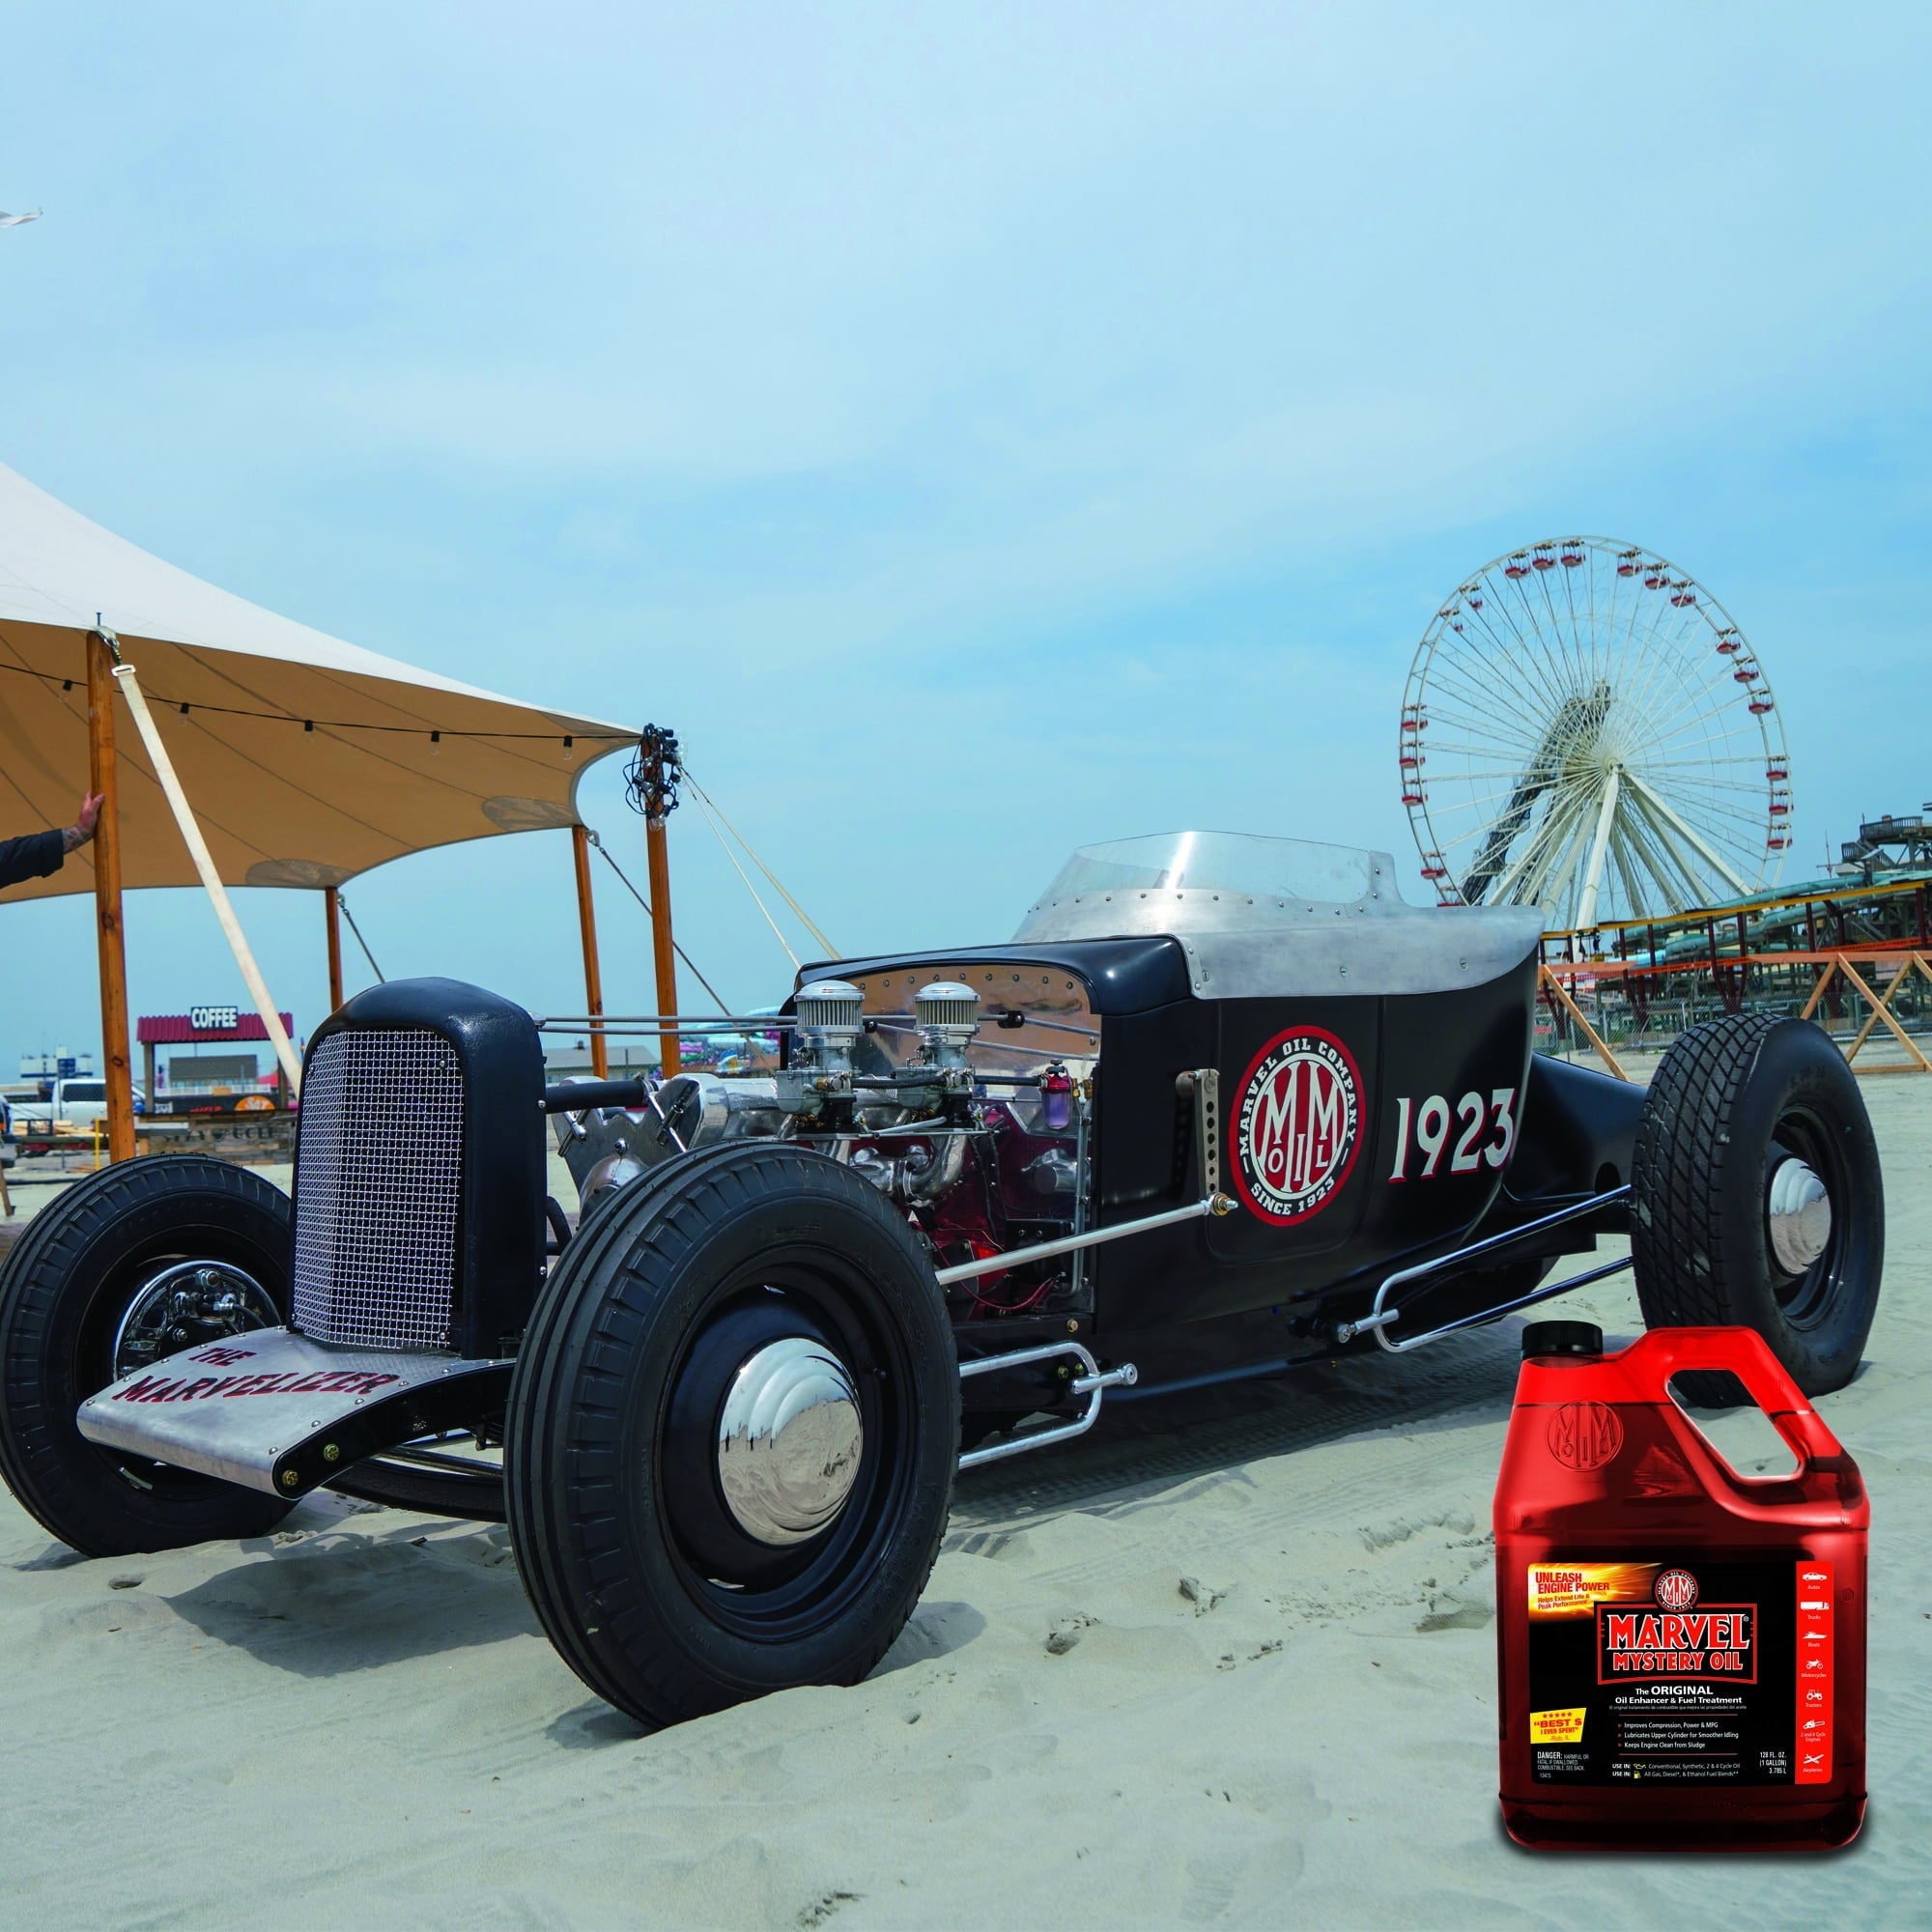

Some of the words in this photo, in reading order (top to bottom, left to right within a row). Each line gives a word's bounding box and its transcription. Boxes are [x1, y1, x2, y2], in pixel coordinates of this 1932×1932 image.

[191, 1008, 237, 1029] COFFEE
[1239, 1056, 1277, 1156] MARVEL
[1283, 1037, 1311, 1056] OIL
[1318, 1041, 1357, 1142] COMPANY
[1388, 1088, 1516, 1184] 1923
[1250, 1182, 1292, 1216] SINCE
[1298, 1178, 1335, 1212] 1923
[188, 1348, 257, 1367] THE
[112, 1371, 401, 1403] MARVELIZER
[1536, 1572, 1581, 1582] UNLEASH
[1538, 1583, 1573, 1594] ENGINE
[1576, 1582, 1609, 1591] POWER
[1605, 1614, 1750, 1650] MARVEL
[1613, 1652, 1704, 1670] MYSTERY
[1710, 1652, 1744, 1670] OIL
[1651, 1686, 1714, 1694] ORIGINAL
